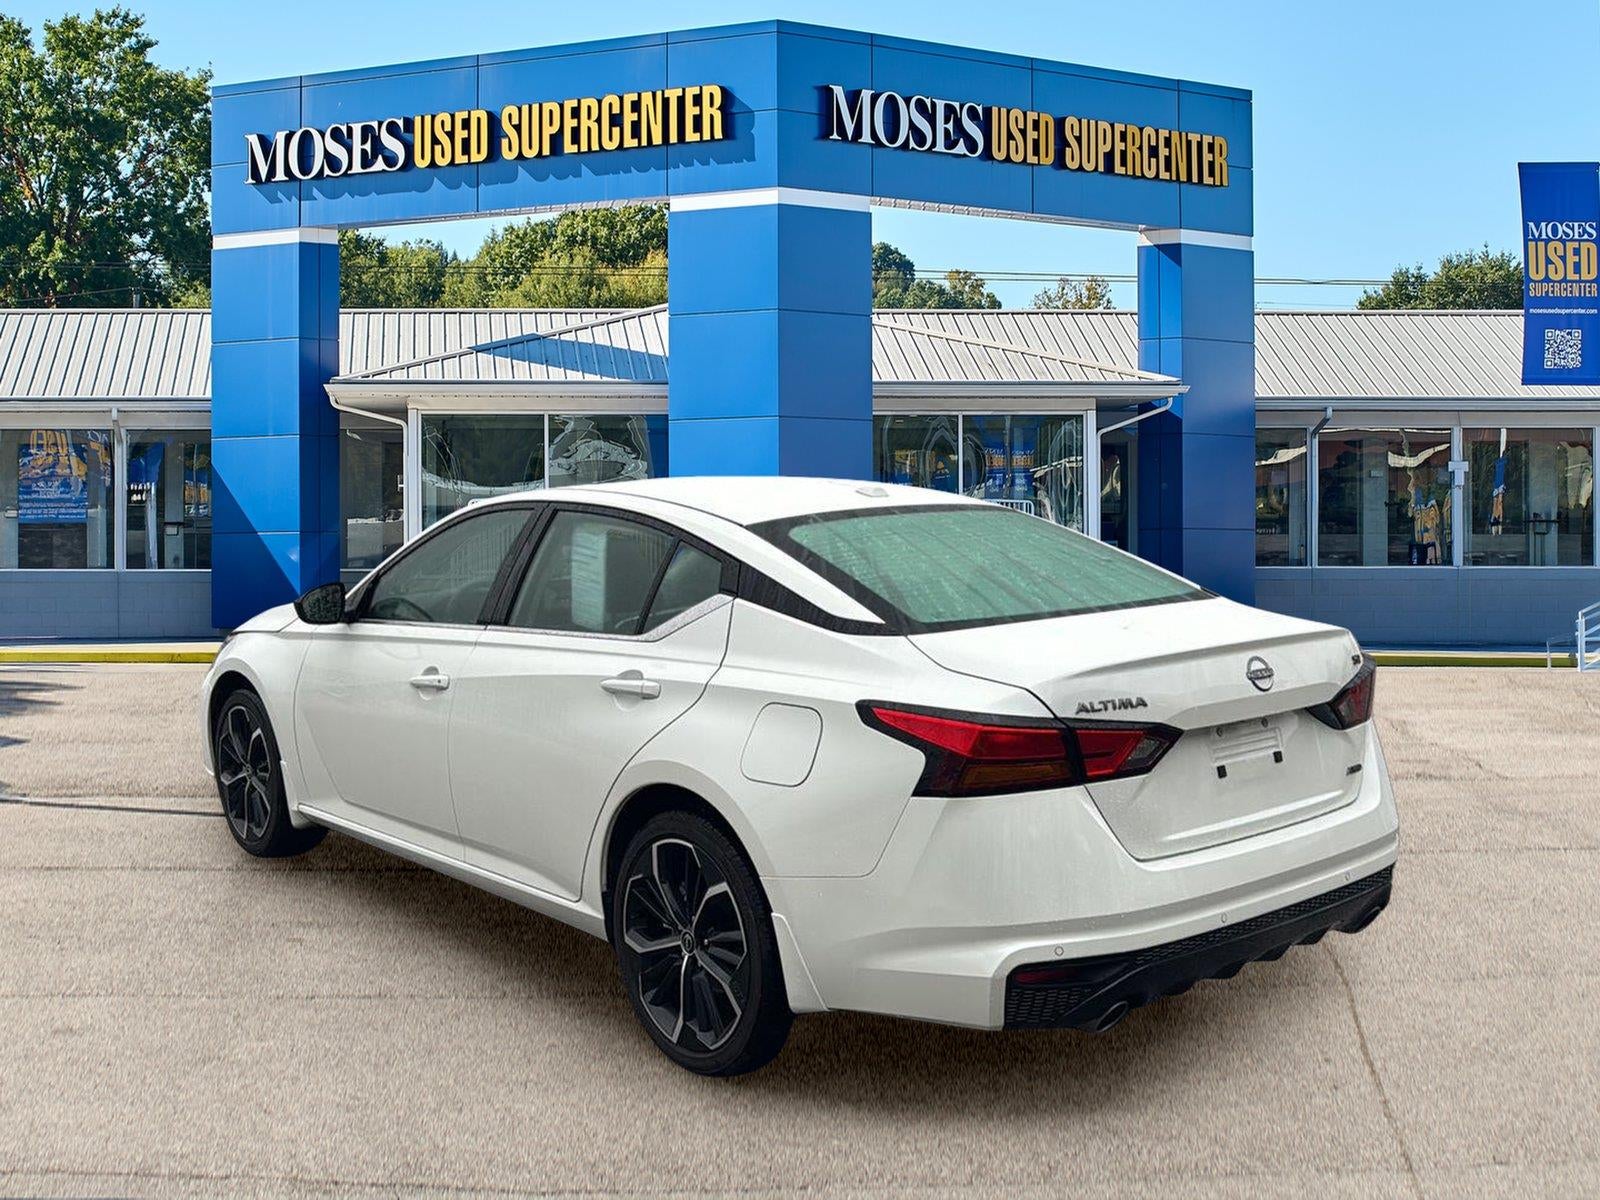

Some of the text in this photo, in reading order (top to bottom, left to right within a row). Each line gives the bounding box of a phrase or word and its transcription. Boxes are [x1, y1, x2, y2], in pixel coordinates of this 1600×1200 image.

[244, 84, 725, 185] MOSES USED SUPERCENTER
[828, 84, 1229, 187] MOSES USED SUPERCENTER
[1527, 221, 1597, 240] MOSES
[1528, 241, 1598, 281] USED
[1529, 283, 1598, 297] SUPERCENTER
[1075, 697, 1148, 715] ALTIMA
